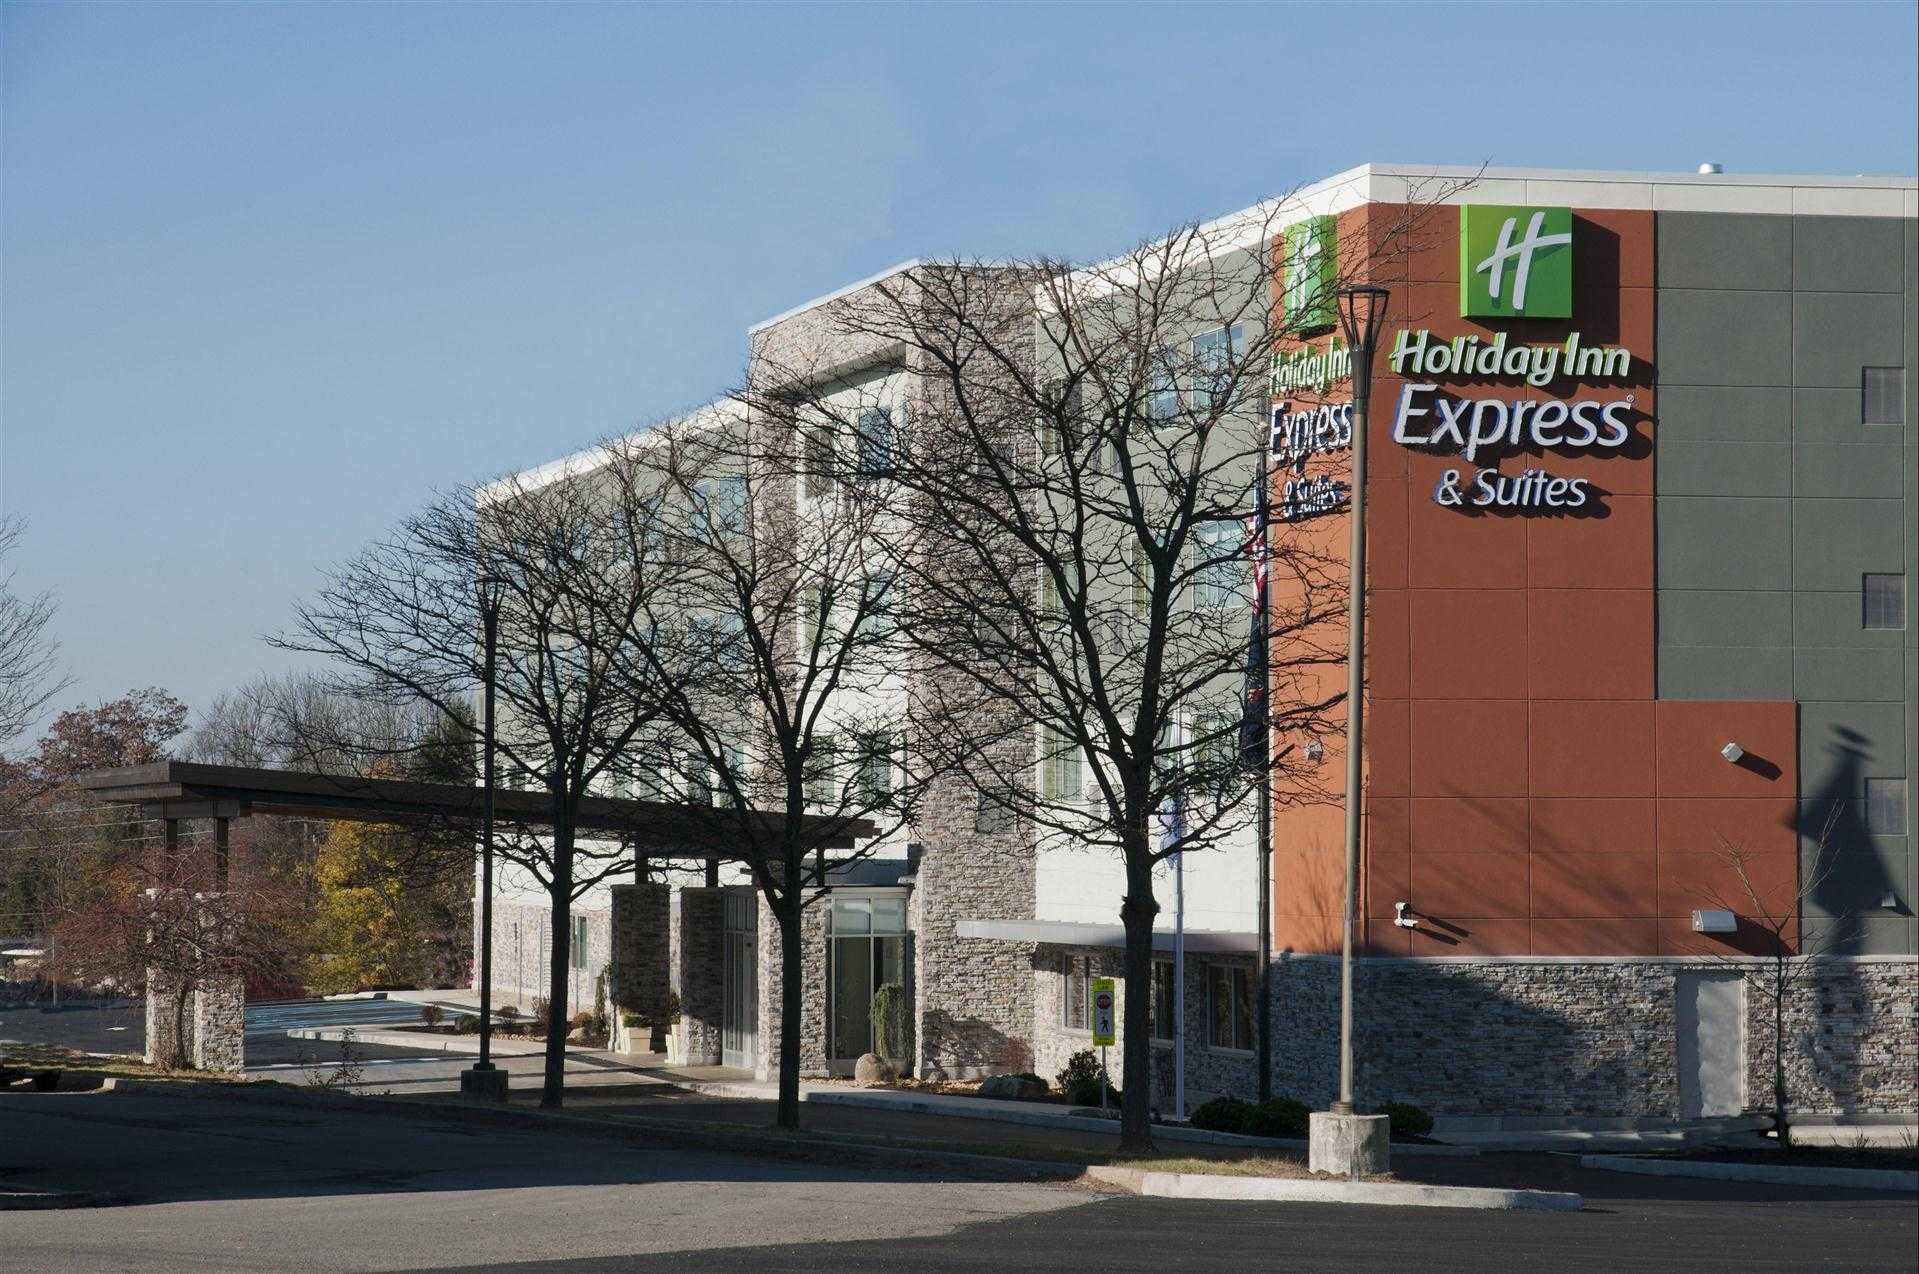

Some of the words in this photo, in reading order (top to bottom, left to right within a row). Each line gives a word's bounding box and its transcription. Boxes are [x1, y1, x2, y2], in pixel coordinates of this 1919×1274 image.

[1267, 345, 1327, 395] Holiday
[1390, 329, 1559, 387] Holiday
[1564, 332, 1631, 377] Inn
[1434, 469, 1463, 506] &
[1473, 468, 1588, 506] Suites
